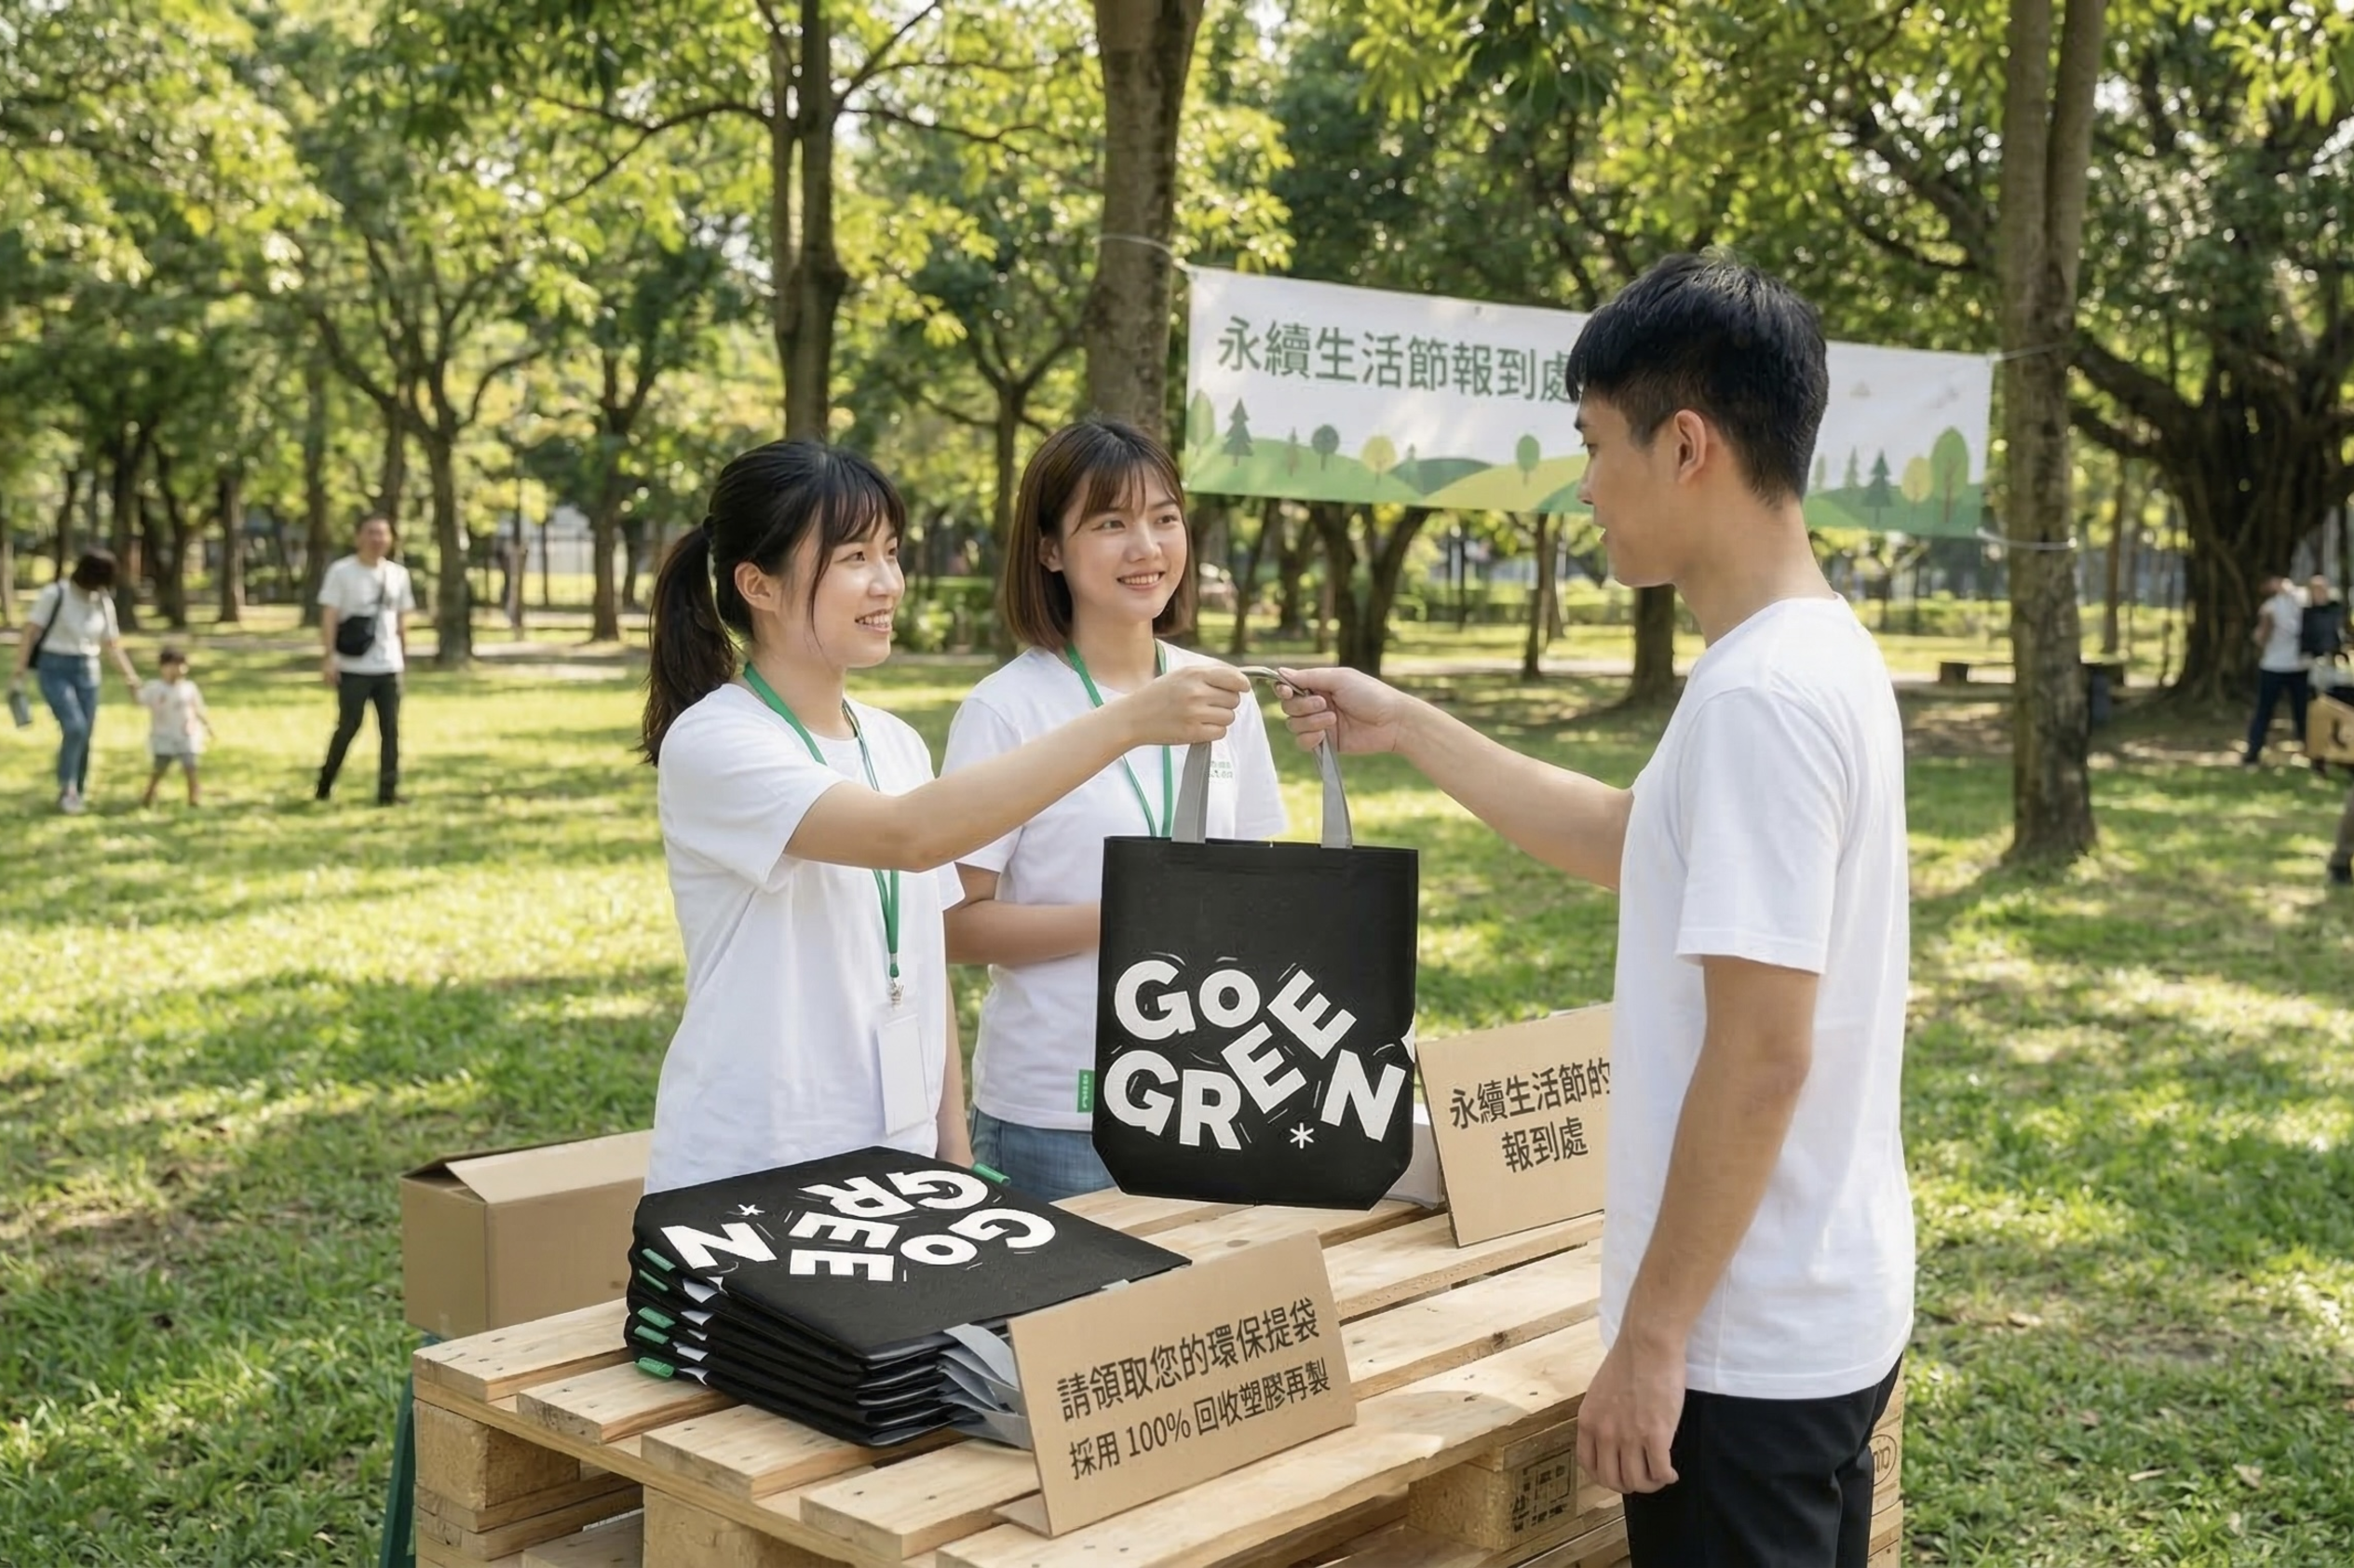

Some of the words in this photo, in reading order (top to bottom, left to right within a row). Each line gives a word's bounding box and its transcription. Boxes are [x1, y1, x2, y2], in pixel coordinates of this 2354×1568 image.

[1115, 959, 1261, 1041] GO
[1449, 1057, 1611, 1129] 永續生活節的
[1501, 1116, 1589, 1173] 報到處
[1056, 1297, 1320, 1423] 請領取您的環保提袋
[1069, 1430, 1120, 1480] 採用
[1126, 1408, 1192, 1458] 100%
[1193, 1357, 1332, 1437] 回收塑膠再製
